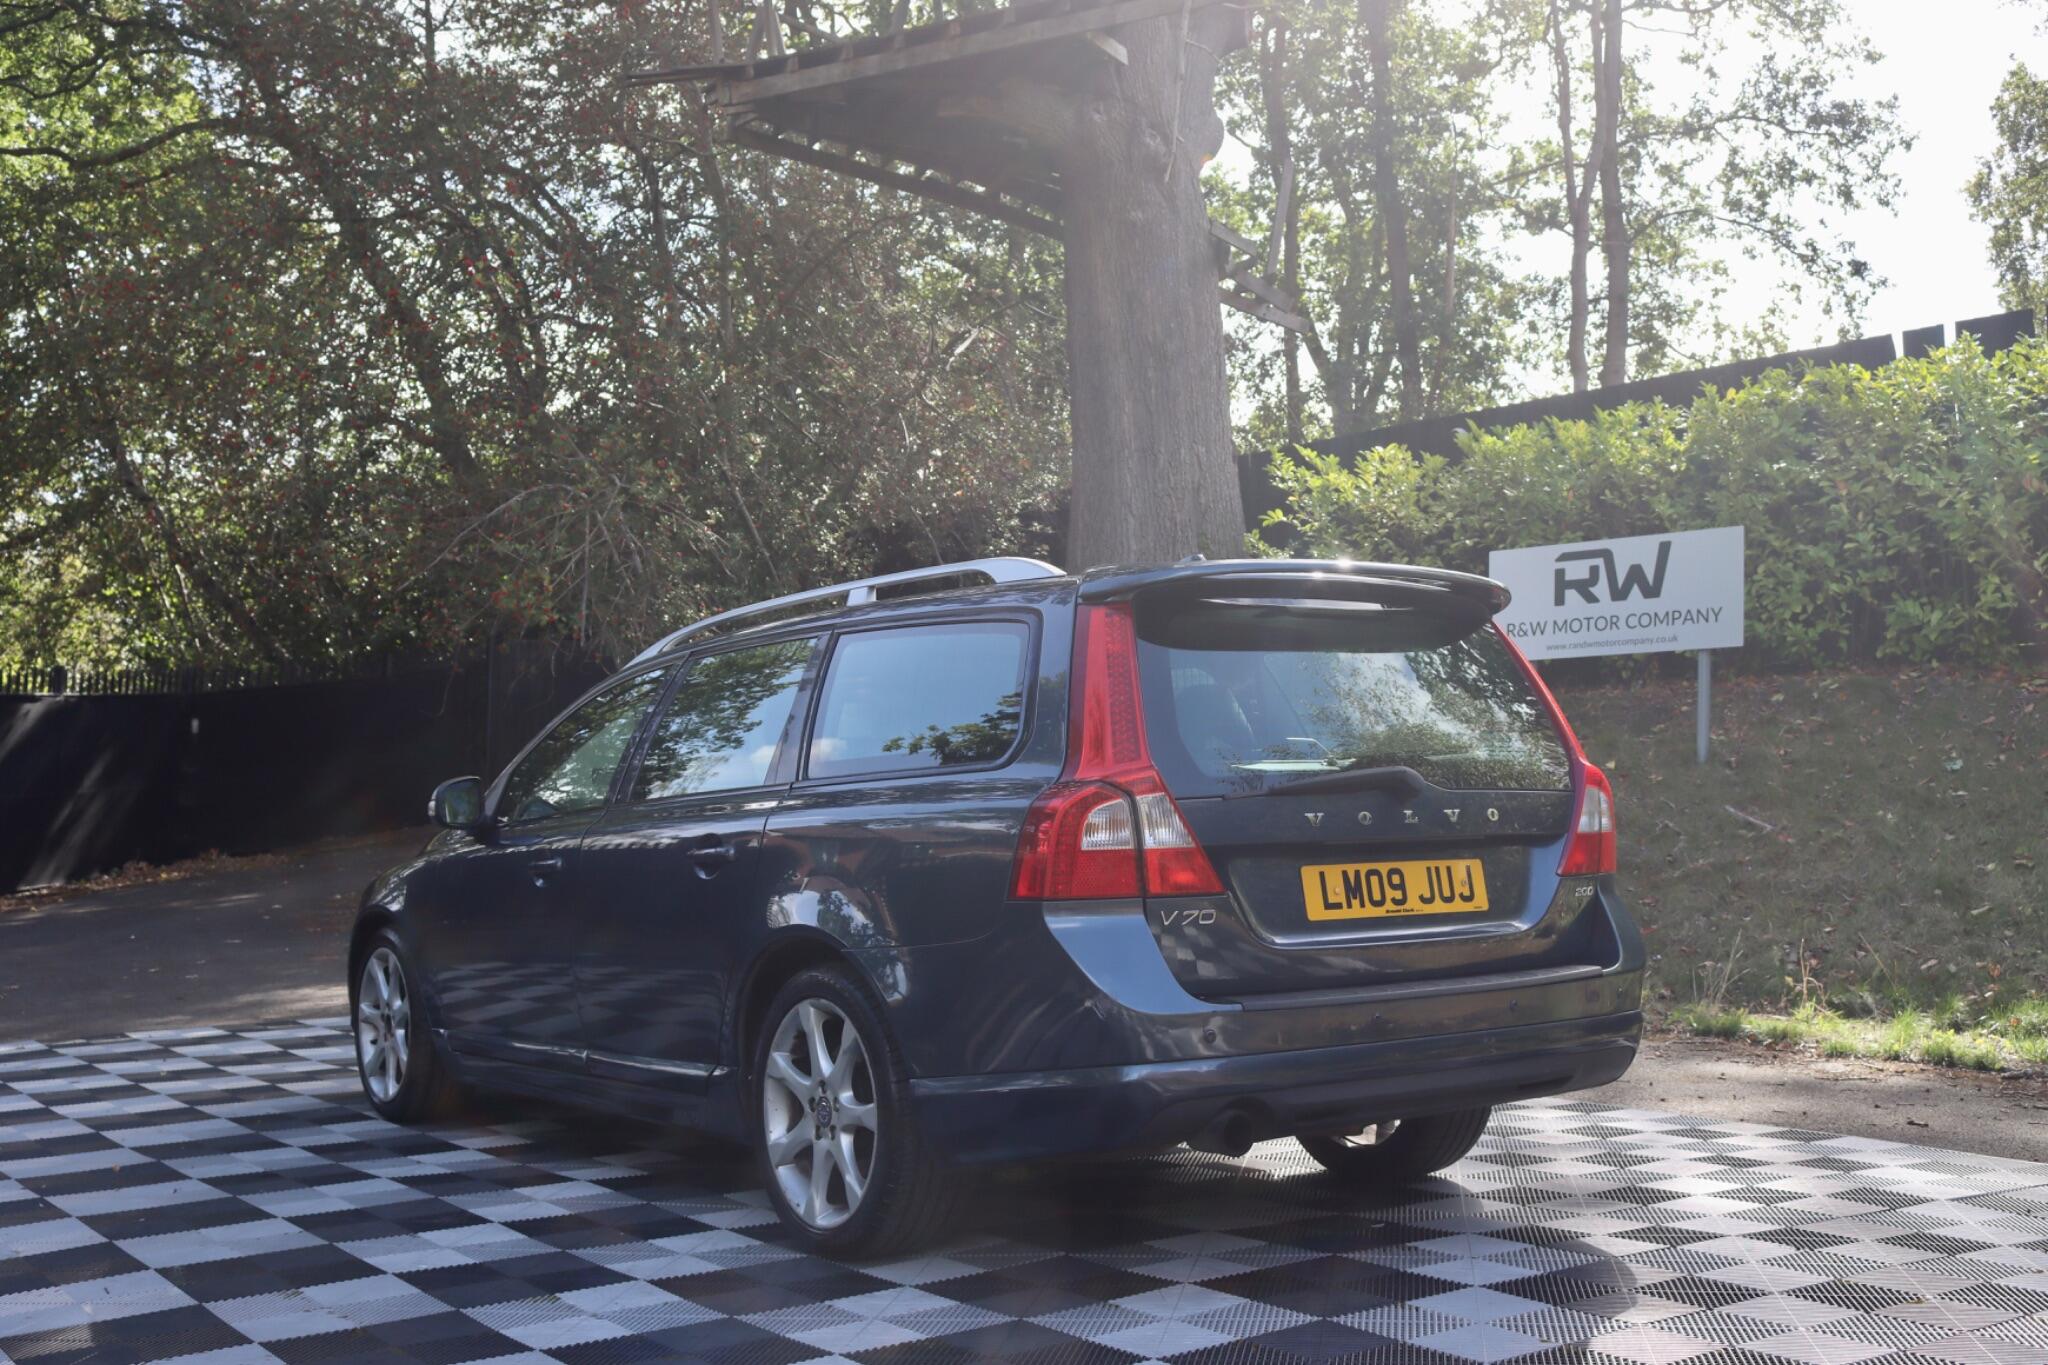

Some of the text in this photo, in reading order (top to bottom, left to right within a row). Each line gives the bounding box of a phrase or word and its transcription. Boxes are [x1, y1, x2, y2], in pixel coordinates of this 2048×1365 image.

[1554, 540, 1672, 607] RW
[1507, 606, 1723, 638] R&W MOTOR COMPANY
[1546, 634, 1679, 652] www.randwmotorcompany.co.uk
[1304, 807, 1500, 827] VOLVO
[1318, 864, 1476, 911] LM09 JUJ
[1161, 909, 1217, 926] V70
